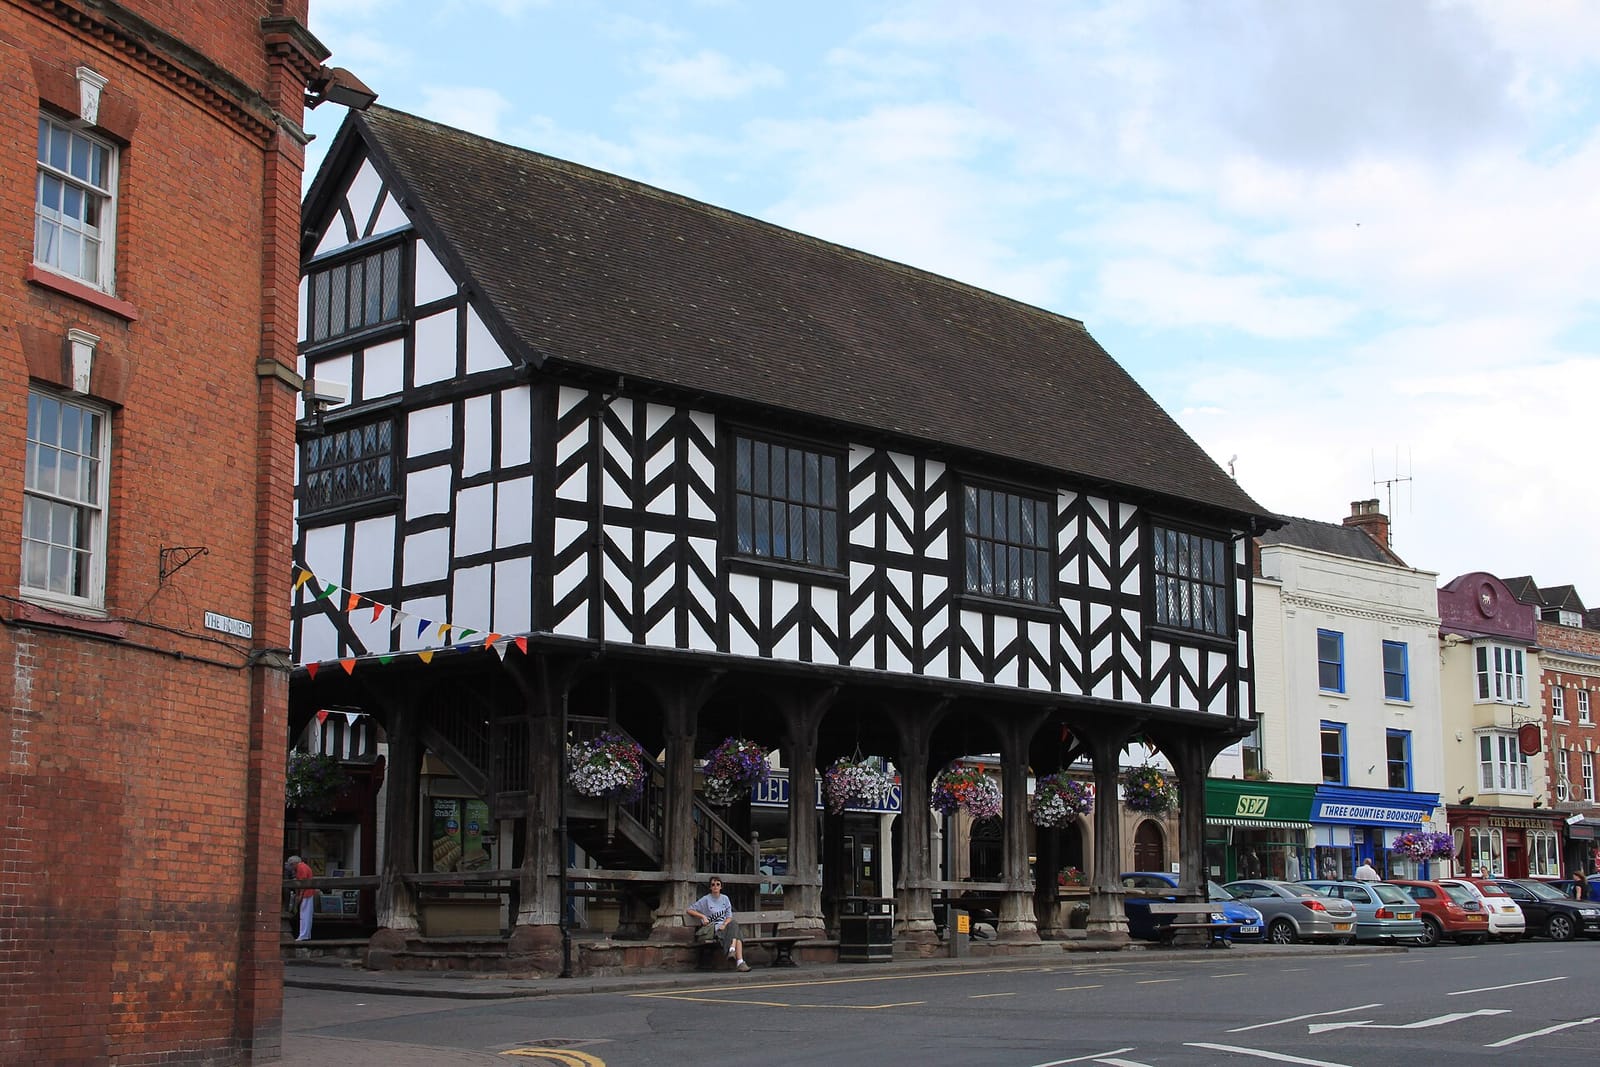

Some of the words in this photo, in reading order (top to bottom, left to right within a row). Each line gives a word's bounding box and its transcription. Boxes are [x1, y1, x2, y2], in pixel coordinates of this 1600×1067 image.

[207, 613, 220, 628] THE
[1237, 796, 1267, 815] SEZ
[1325, 805, 1349, 817] THREE
[1349, 807, 1384, 819] COUNTIES
[1386, 809, 1423, 822] BOOKSHOP
[1489, 817, 1507, 827] THE
[1508, 818, 1547, 829] RETREAT
